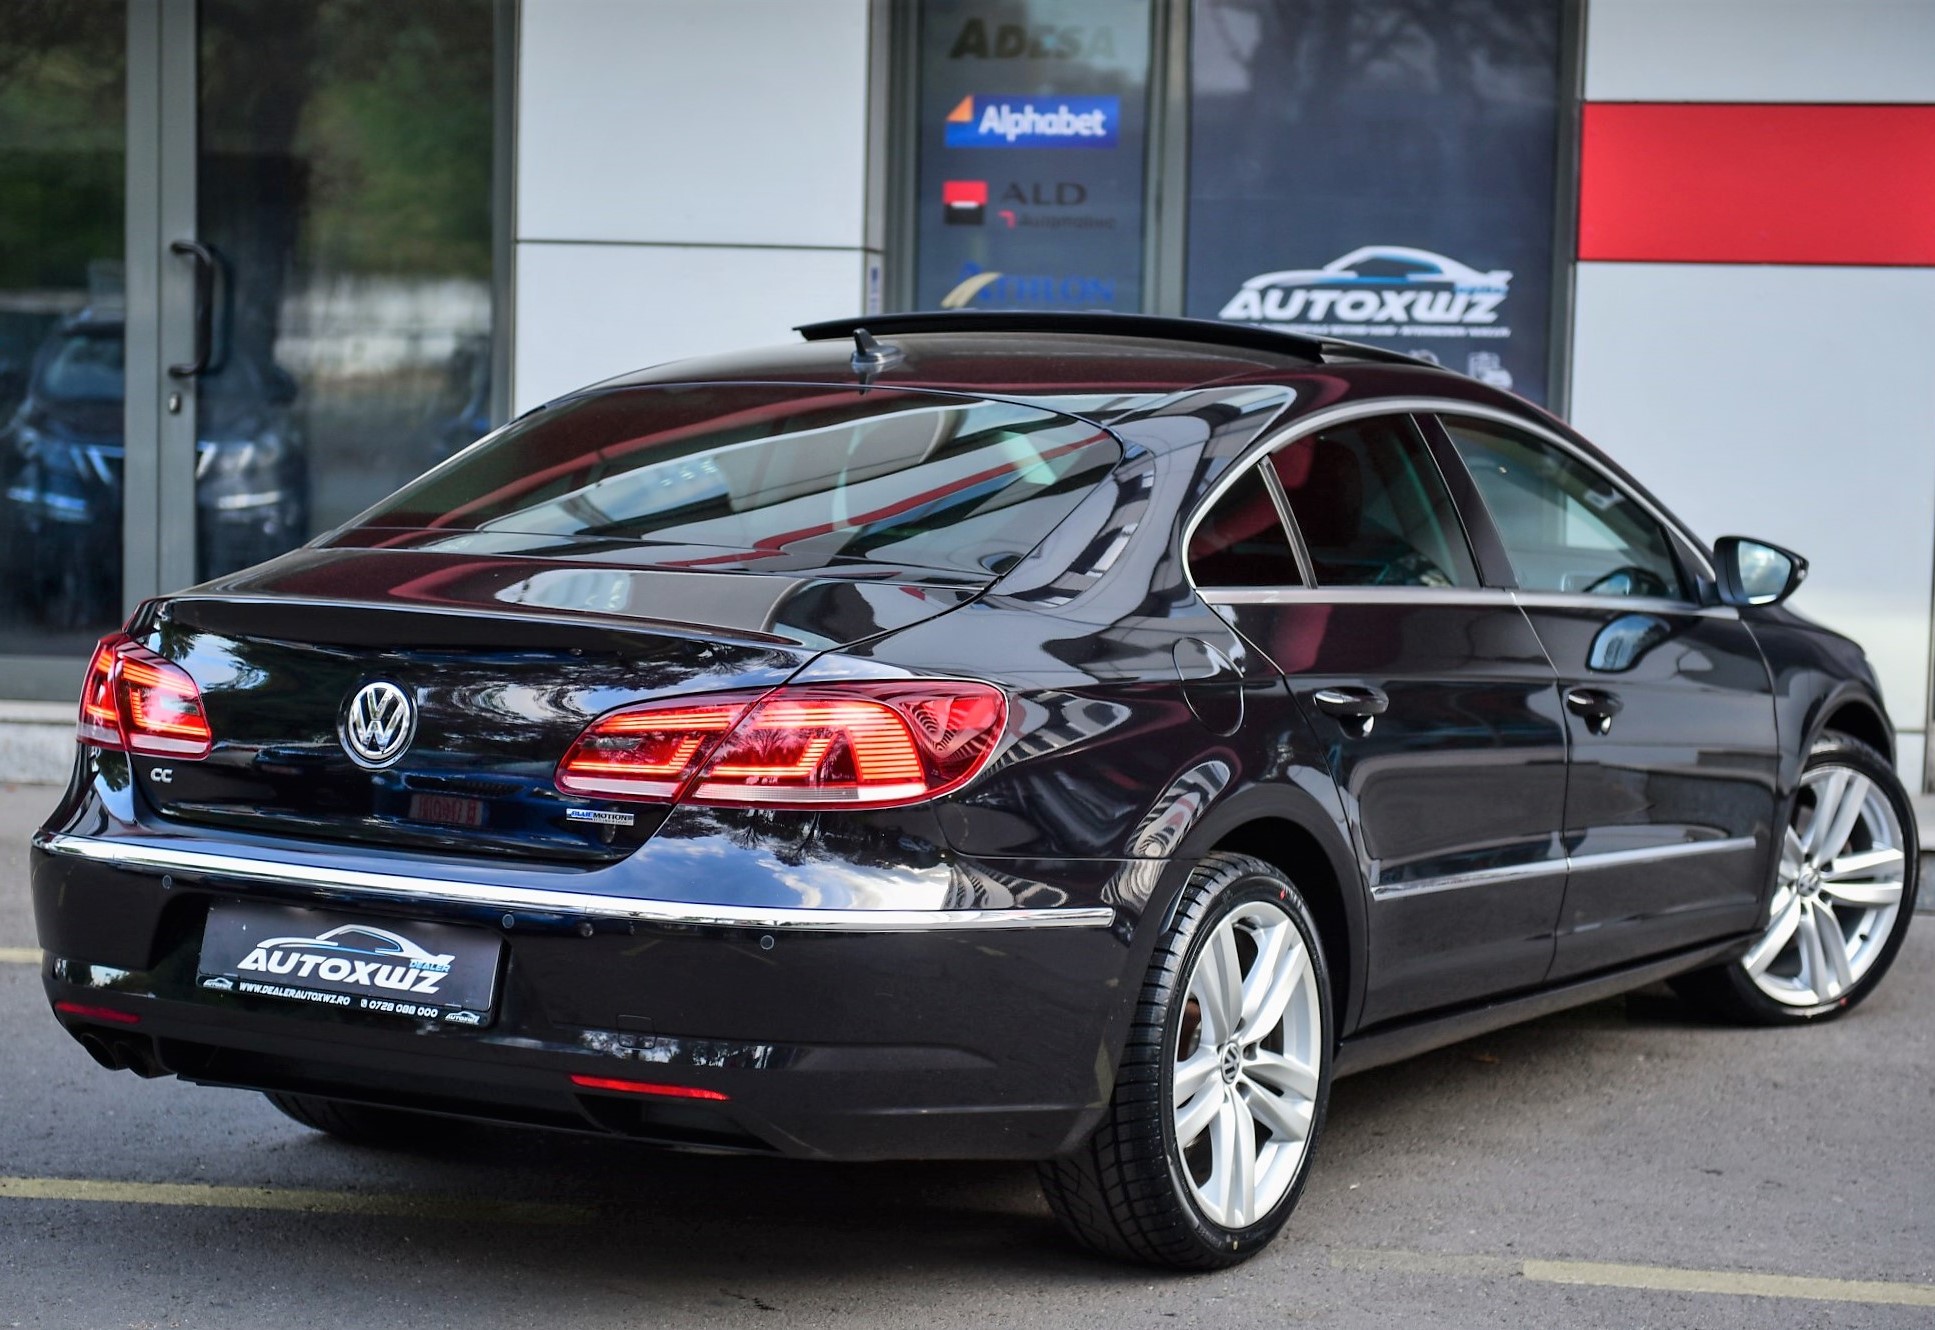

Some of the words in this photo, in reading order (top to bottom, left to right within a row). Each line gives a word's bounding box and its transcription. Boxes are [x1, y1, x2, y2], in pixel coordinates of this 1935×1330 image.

[978, 104, 1107, 142] Alphabet
[1003, 182, 1087, 206] ALD
[1219, 288, 1506, 323] AUTOXWZ
[150, 767, 173, 783] CC
[237, 948, 449, 994] AUTOXWZ
[409, 959, 451, 972] DEALER
[239, 982, 350, 1005] WWW.DEALERAUTOXWZ.RO
[369, 1001, 394, 1013] 0728
[416, 1007, 438, 1018] 000
